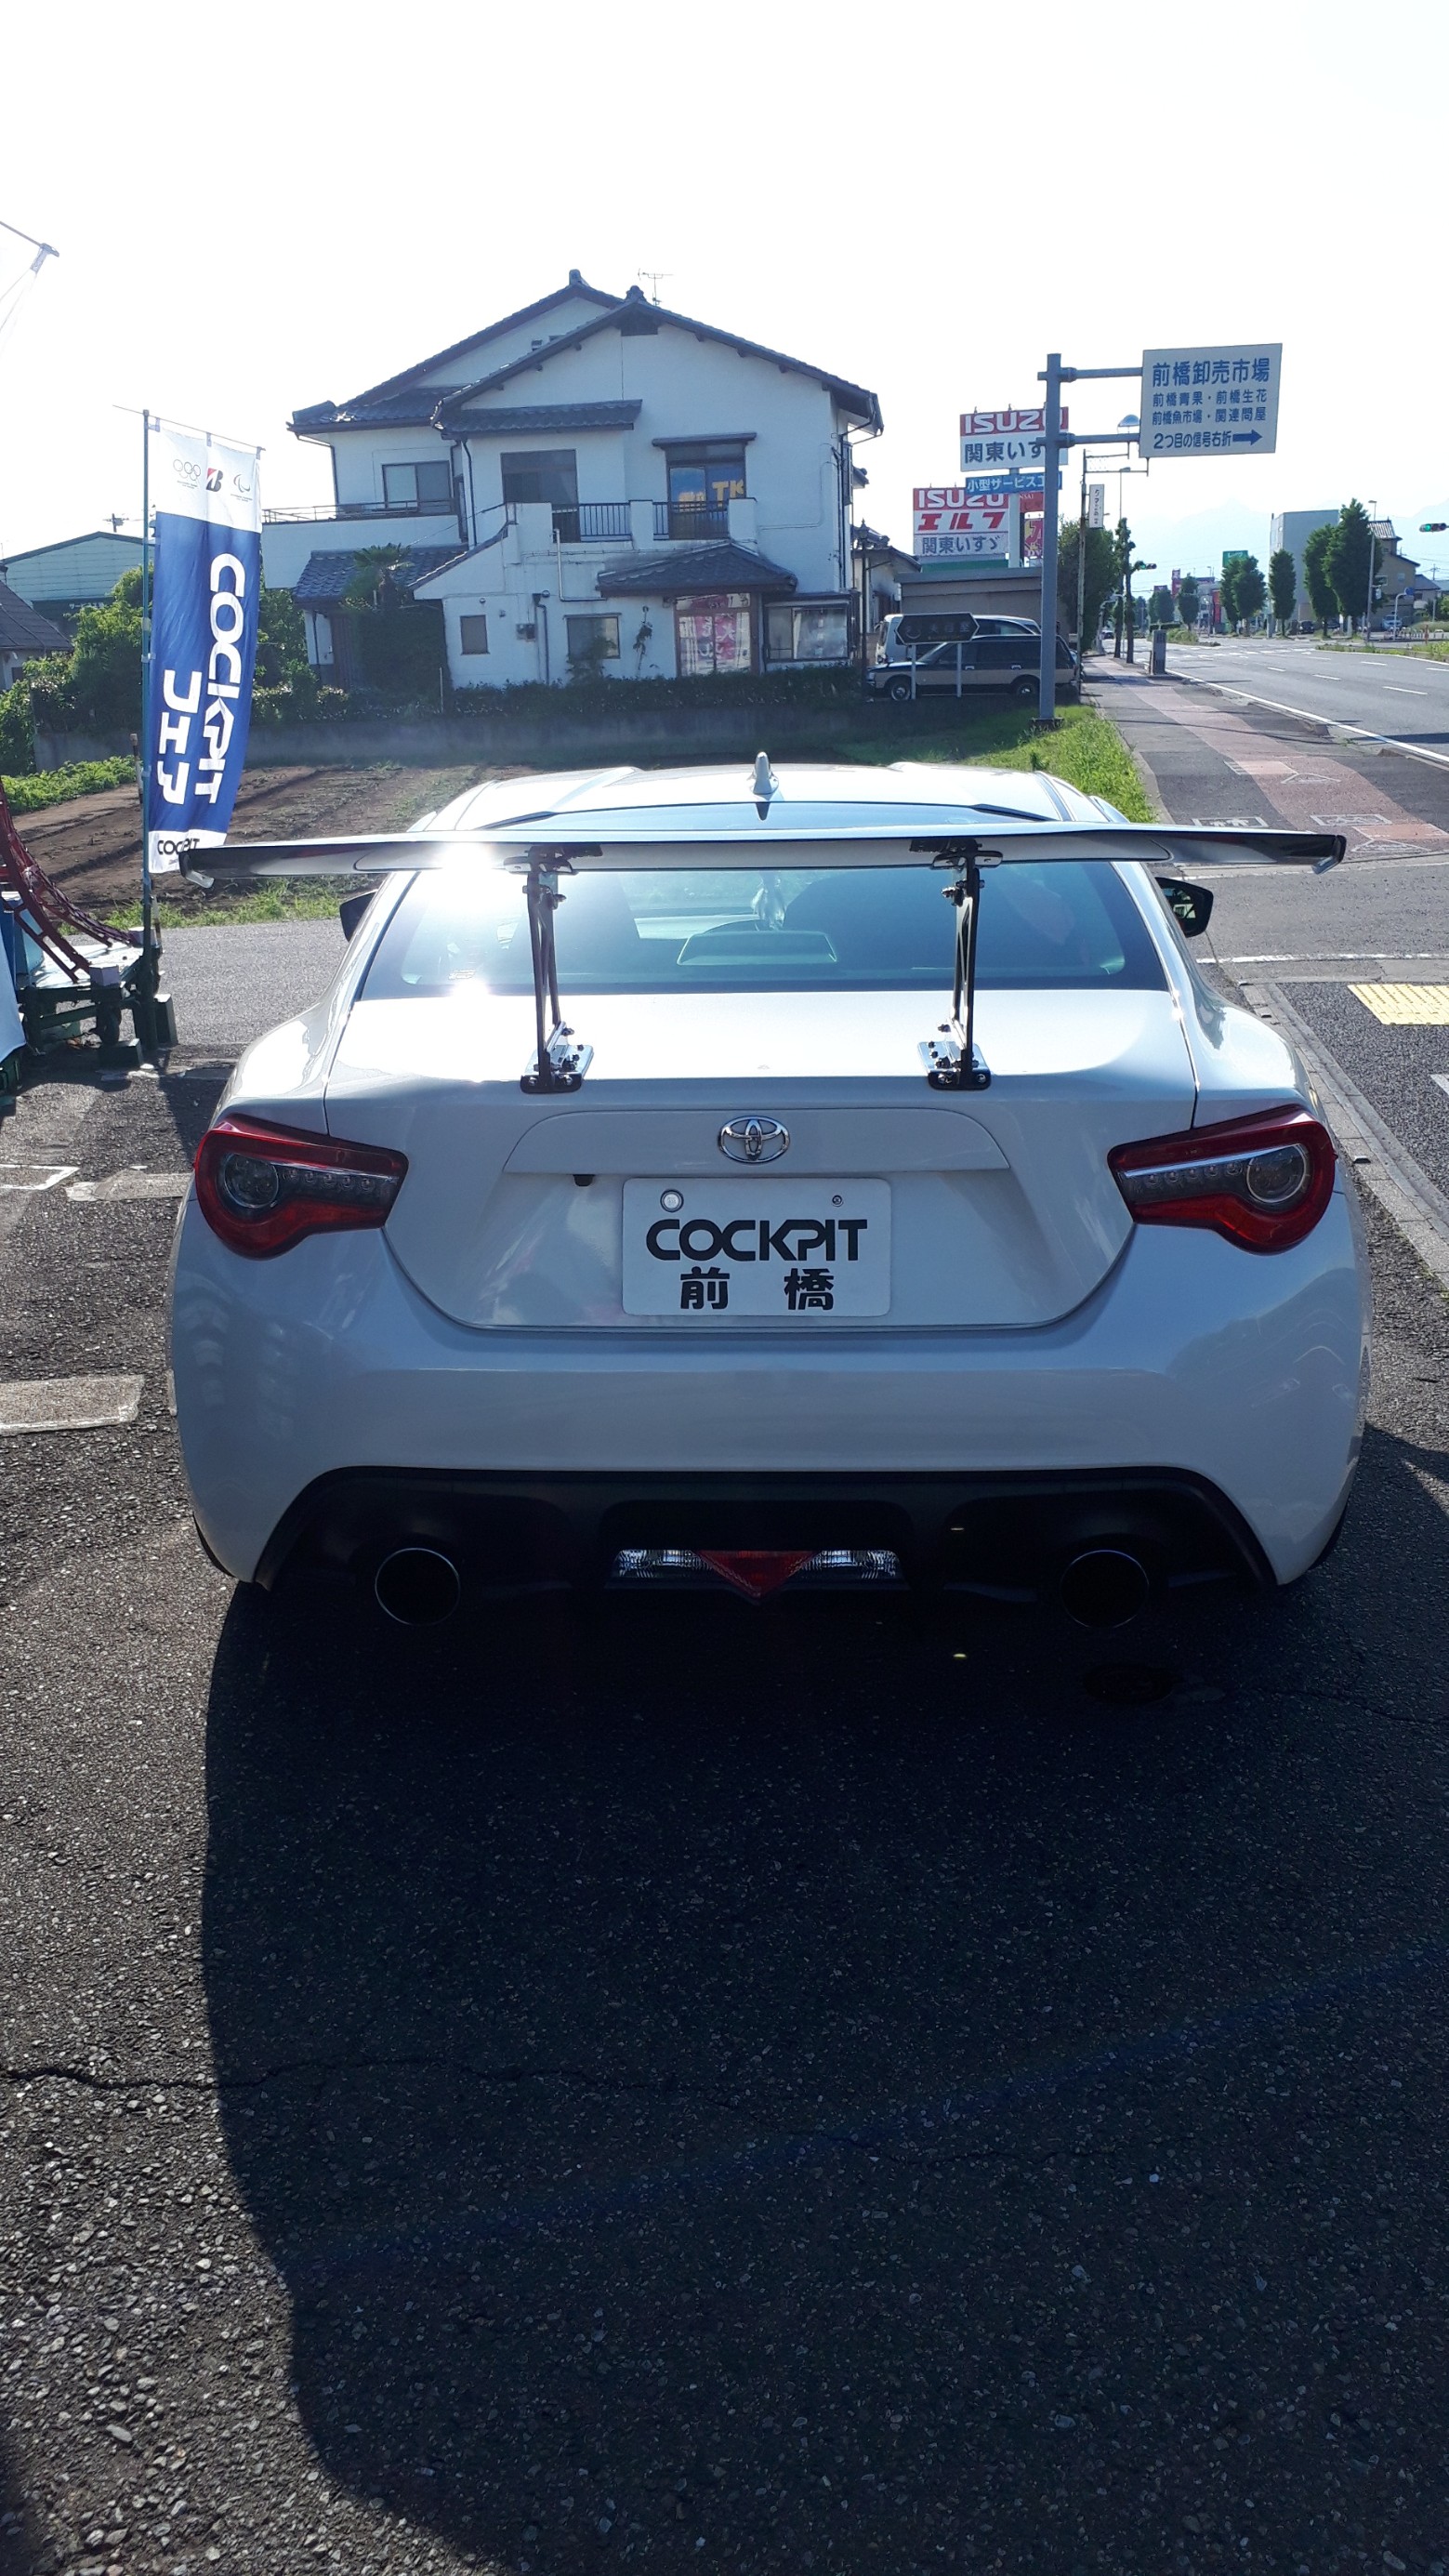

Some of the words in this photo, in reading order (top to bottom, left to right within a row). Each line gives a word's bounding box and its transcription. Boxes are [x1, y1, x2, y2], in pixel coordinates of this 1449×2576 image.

[1153, 357, 1271, 388] 前橋卸売市場
[1153, 430, 1232, 449] 2つ目の信号右折
[965, 442, 1042, 463] 関東いす
[918, 489, 1005, 509] ISUZU
[917, 511, 1006, 531] エルフ
[194, 552, 245, 804] COCKPIT
[646, 1219, 867, 1261] COCKPIT
